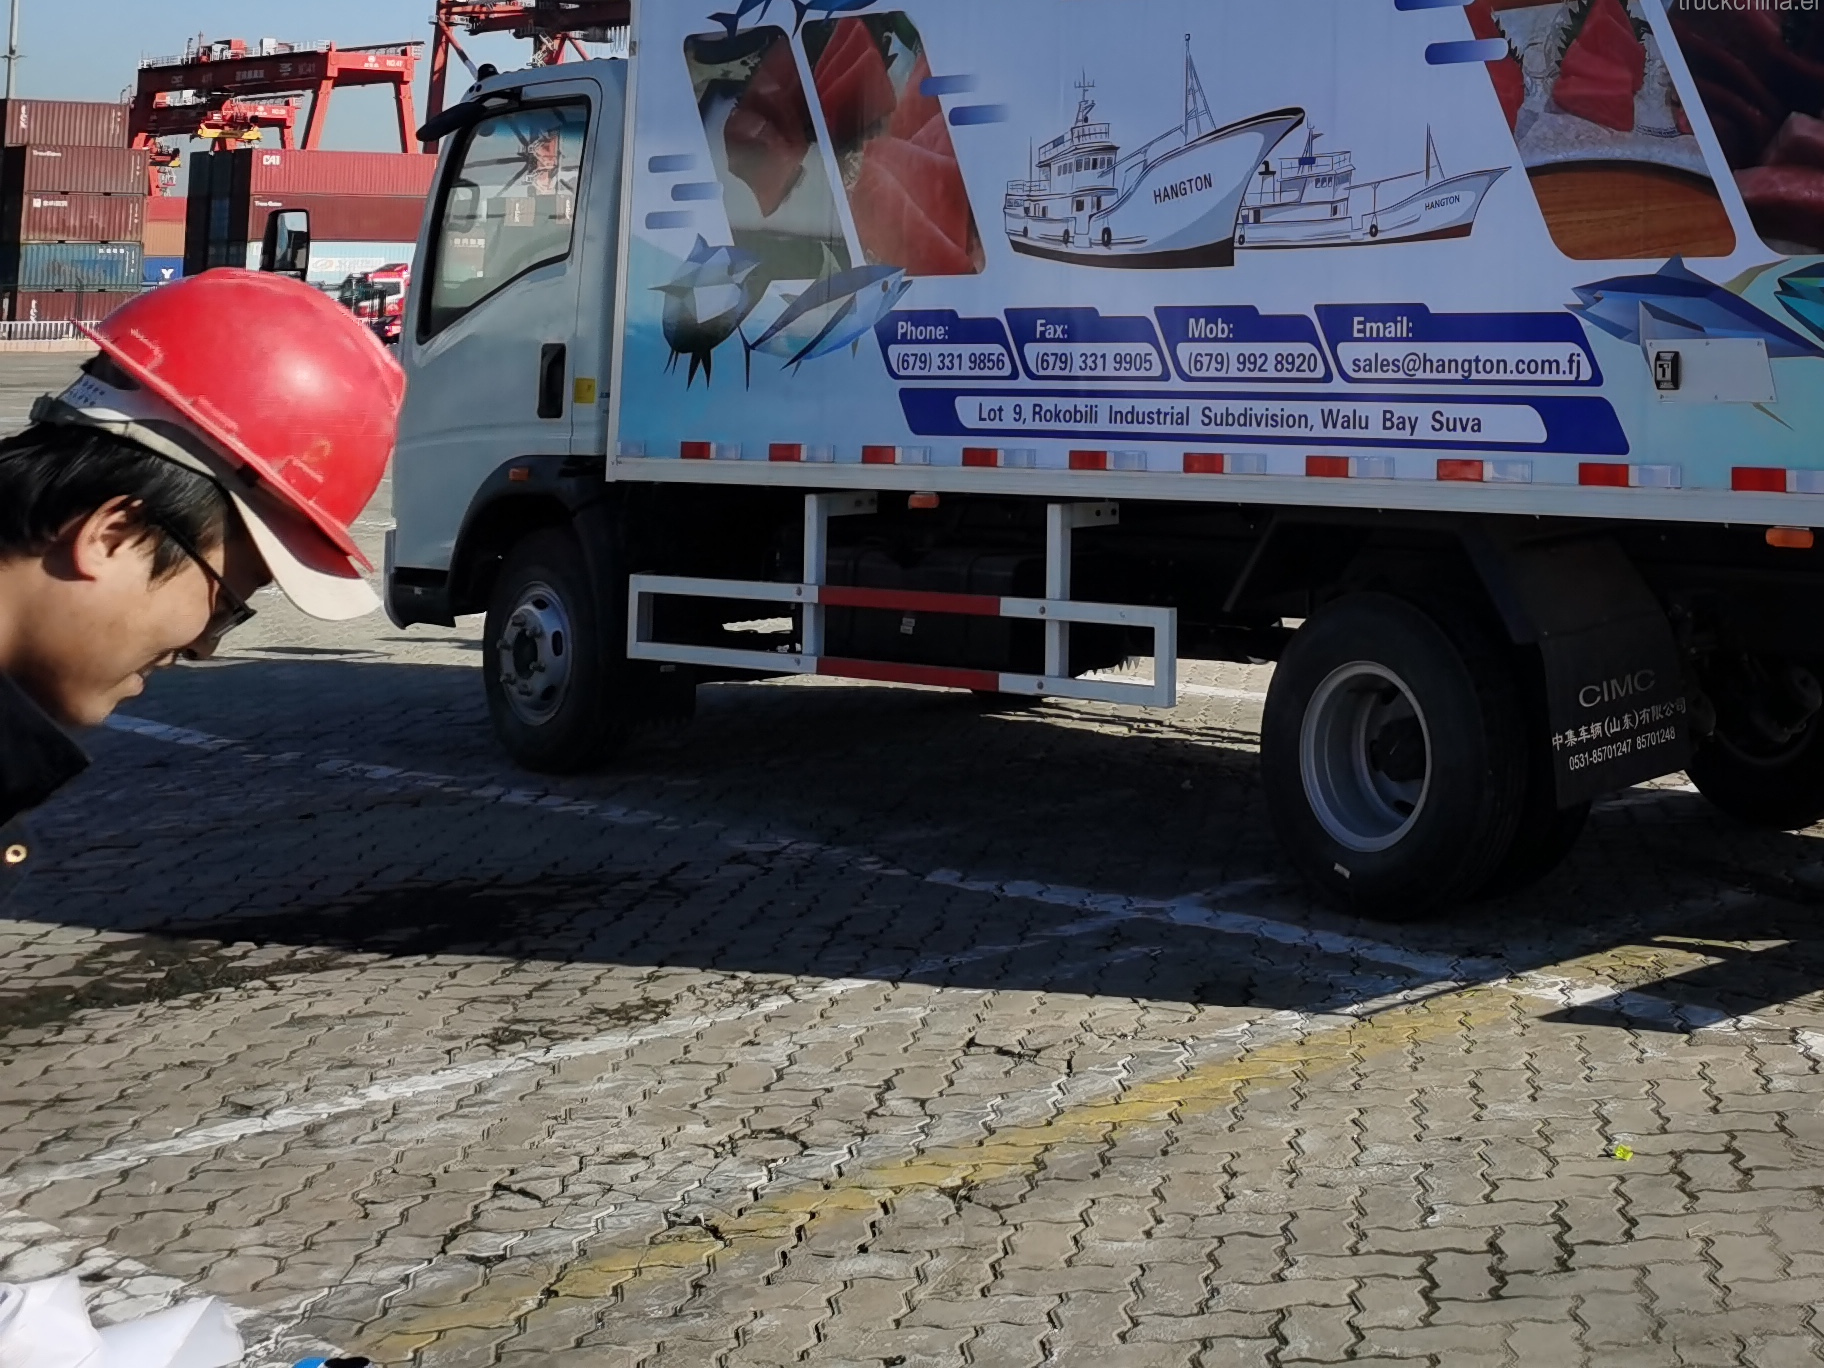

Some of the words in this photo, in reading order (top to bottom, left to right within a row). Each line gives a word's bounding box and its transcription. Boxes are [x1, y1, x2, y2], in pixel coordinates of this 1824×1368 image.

[1154, 173, 1213, 205] HANGTON
[1425, 194, 1461, 212] HANGTON
[897, 321, 949, 340] Phone:
[1036, 319, 1068, 339] Fax:
[1188, 317, 1234, 339] Mob:
[1353, 316, 1413, 338] Email:
[896, 352, 932, 373] (679)
[937, 353, 963, 371] 331
[968, 352, 1005, 371] 9856
[1035, 352, 1073, 373] (679)
[1079, 353, 1107, 372] 331
[1113, 352, 1153, 372] 9905
[1188, 352, 1230, 374] (679)
[1236, 353, 1268, 373] 992
[1274, 352, 1318, 373] 8920
[1352, 352, 1581, 380] sales@hangton.com.fj
[978, 402, 1004, 422] Lot
[1013, 405, 1026, 425] 9,
[1032, 404, 1098, 424] Rokobili
[1108, 404, 1190, 426] Industrial
[1201, 406, 1314, 432] Subdivision,
[1321, 408, 1369, 431] Walu
[1382, 409, 1418, 436] Bay
[1431, 410, 1482, 433] Suva
[1578, 669, 1656, 708] CIMC
[1552, 697, 1687, 752] 中集车辆(山东)有限公司
[1569, 739, 1632, 771] 0531-85701247
[1636, 726, 1676, 750] 85701248
